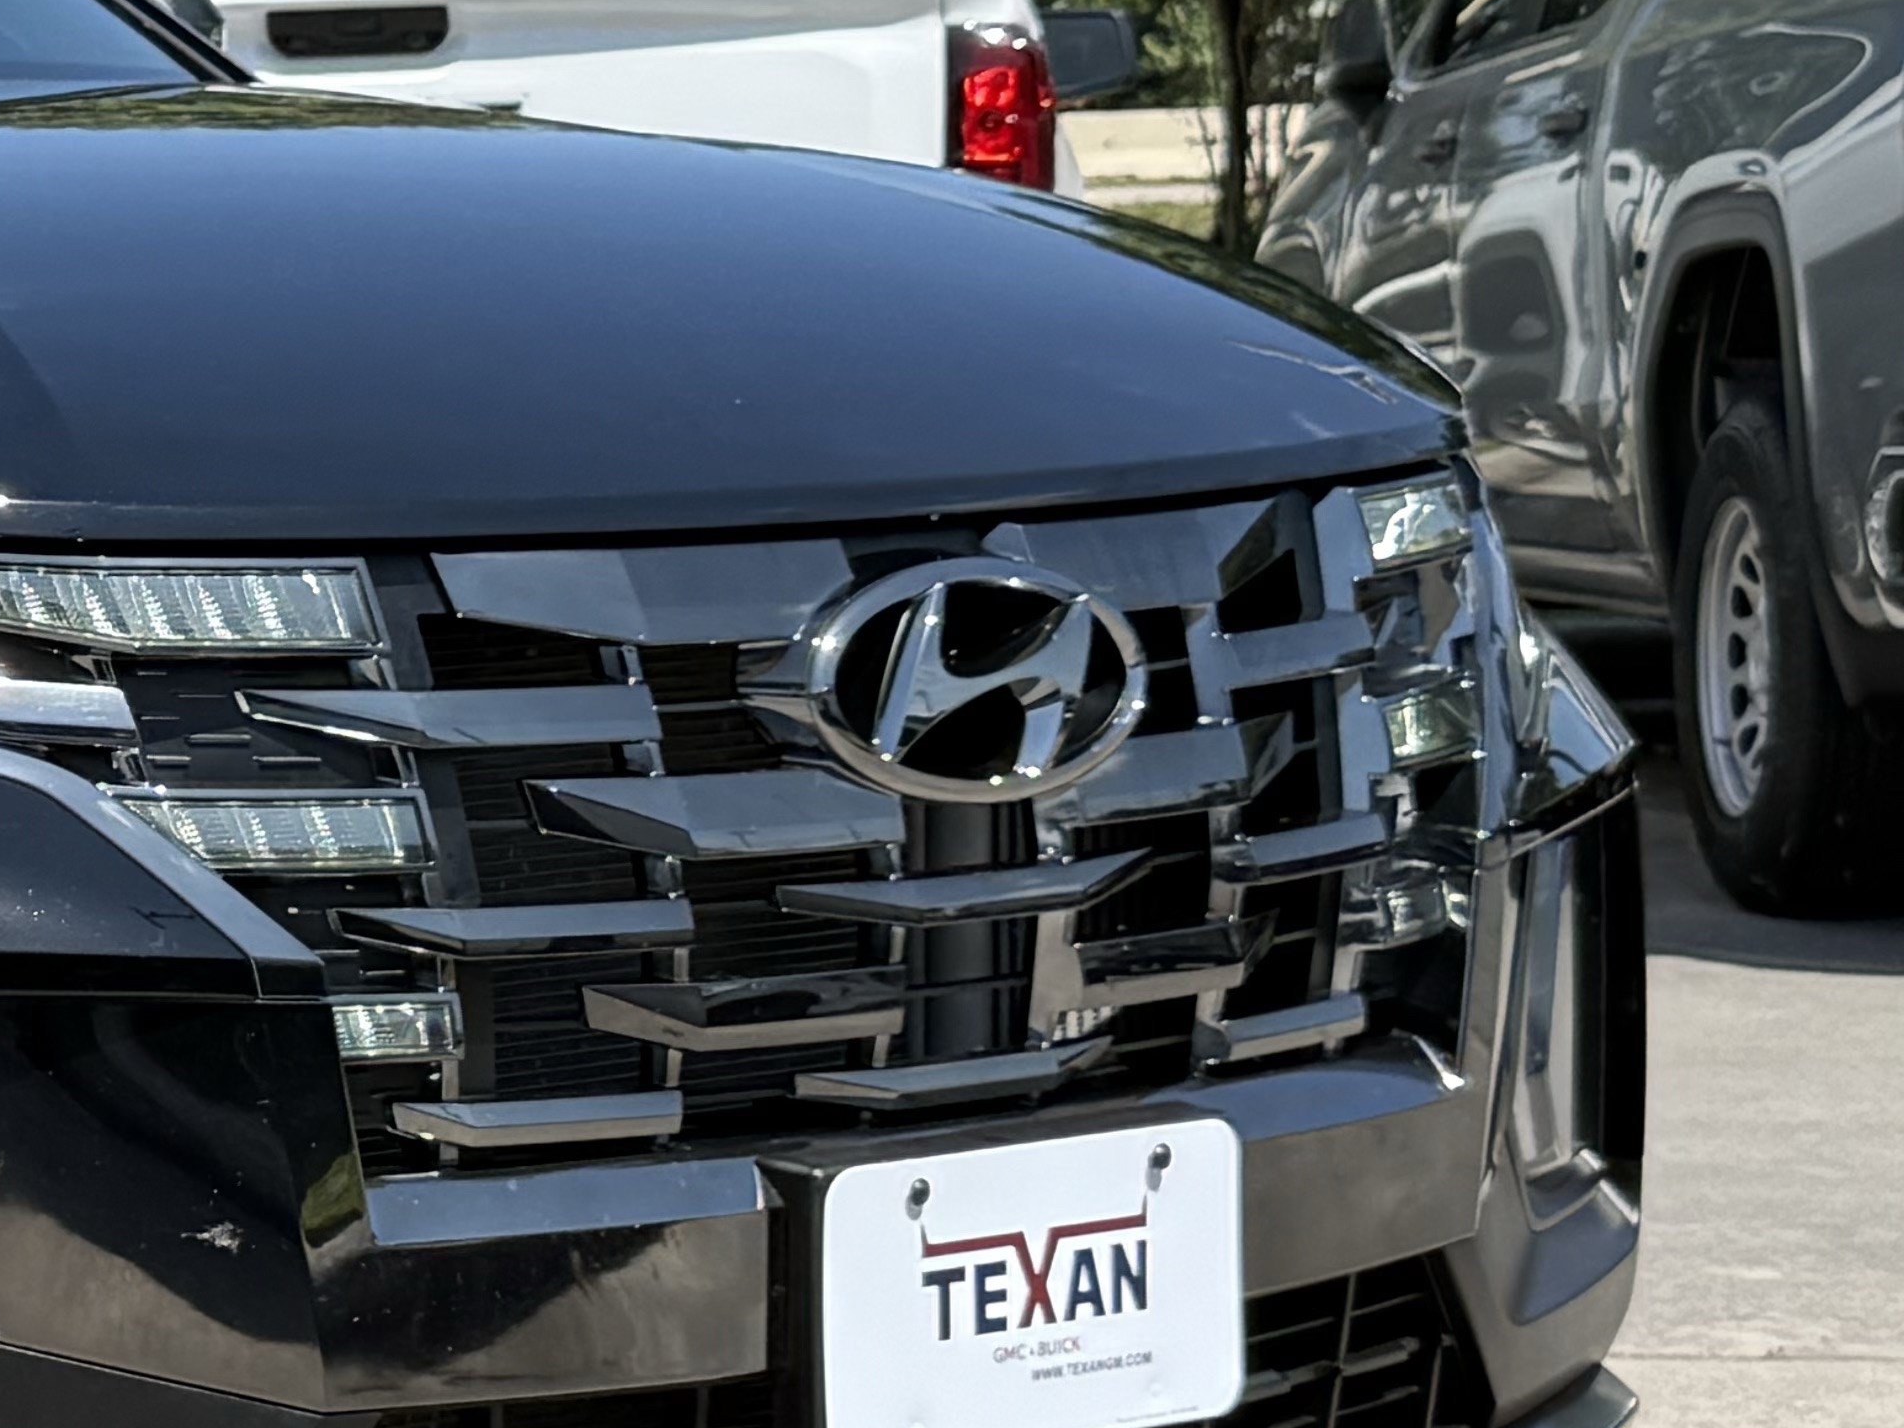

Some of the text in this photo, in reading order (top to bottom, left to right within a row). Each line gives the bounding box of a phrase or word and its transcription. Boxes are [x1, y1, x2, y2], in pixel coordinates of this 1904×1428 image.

[921, 1222, 1147, 1341] TEXAN
[993, 1336, 1081, 1363] GMC BUICK
